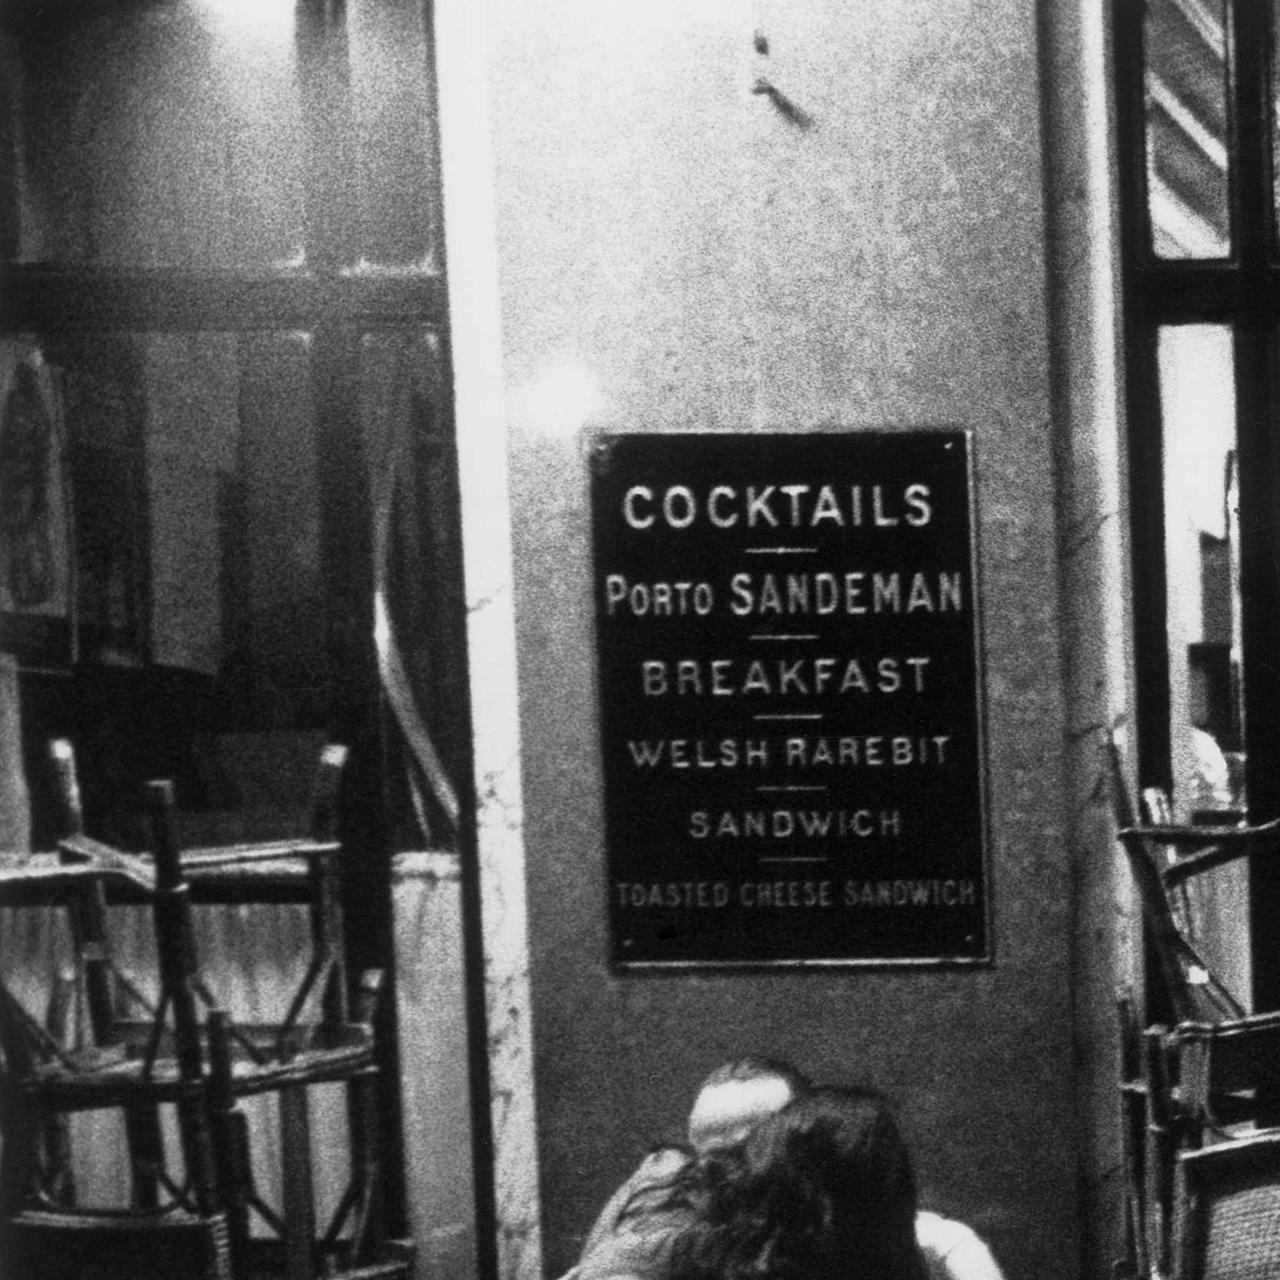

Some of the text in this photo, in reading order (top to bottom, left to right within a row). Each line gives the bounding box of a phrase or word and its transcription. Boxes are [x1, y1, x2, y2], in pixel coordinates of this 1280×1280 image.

[623, 484, 931, 529] COCKTAILS
[606, 573, 961, 616] PORTO SANDEMAN
[642, 657, 929, 696] BREAKFAST
[628, 735, 949, 769] WELSH RAREBIT
[690, 809, 899, 838] SANDWICH
[616, 879, 974, 907] TOASTED CHEESE SANDWICH
